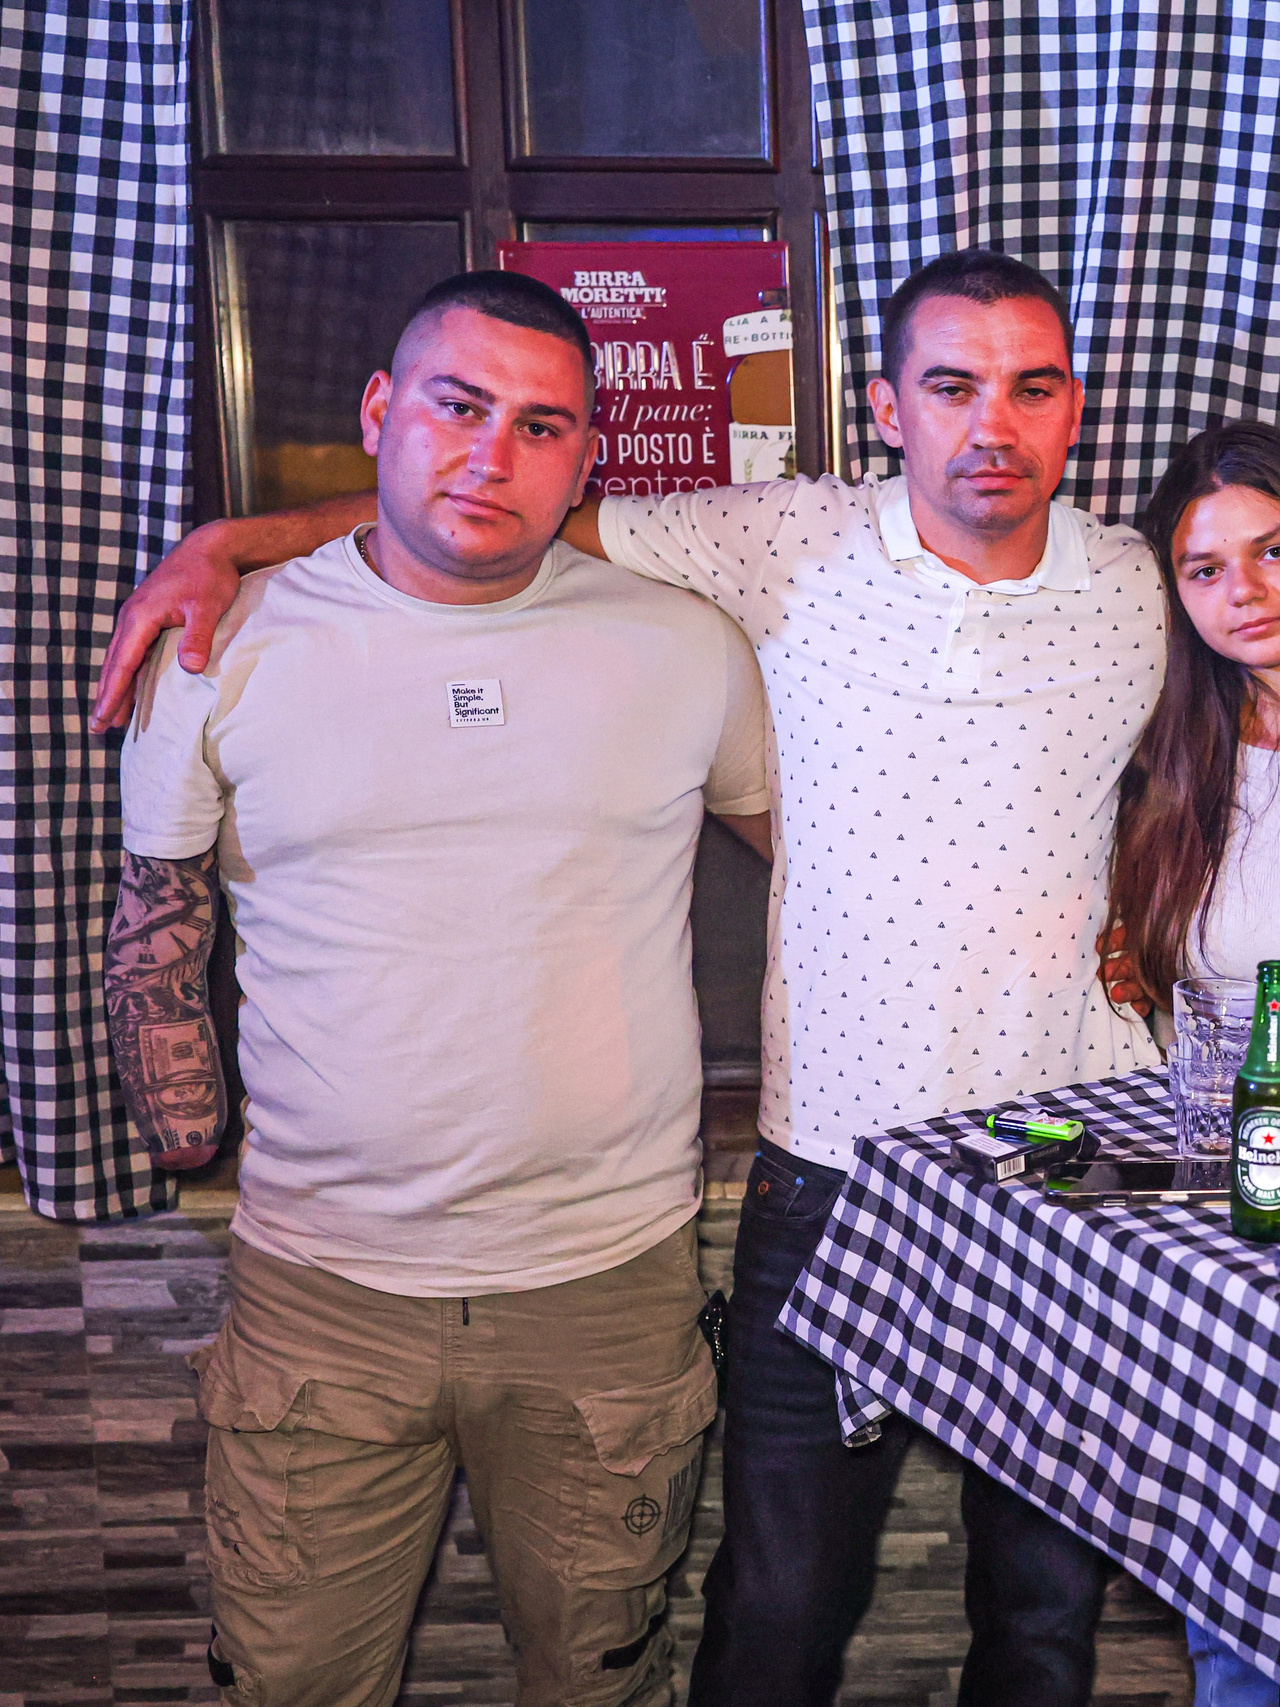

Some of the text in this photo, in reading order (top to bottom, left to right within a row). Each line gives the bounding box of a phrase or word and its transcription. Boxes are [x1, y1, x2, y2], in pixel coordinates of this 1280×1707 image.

[574, 271, 647, 287] BIRRA
[560, 287, 663, 303] MORETTI
[581, 307, 643, 319] L'AUTENTICA
[726, 317, 749, 327] LIA
[751, 332, 792, 343] BOTTI
[610, 394, 630, 422] il
[633, 403, 713, 431] pane:
[617, 433, 693, 465] POSTO
[702, 426, 717, 464] È
[455, 707, 500, 717] Significant
